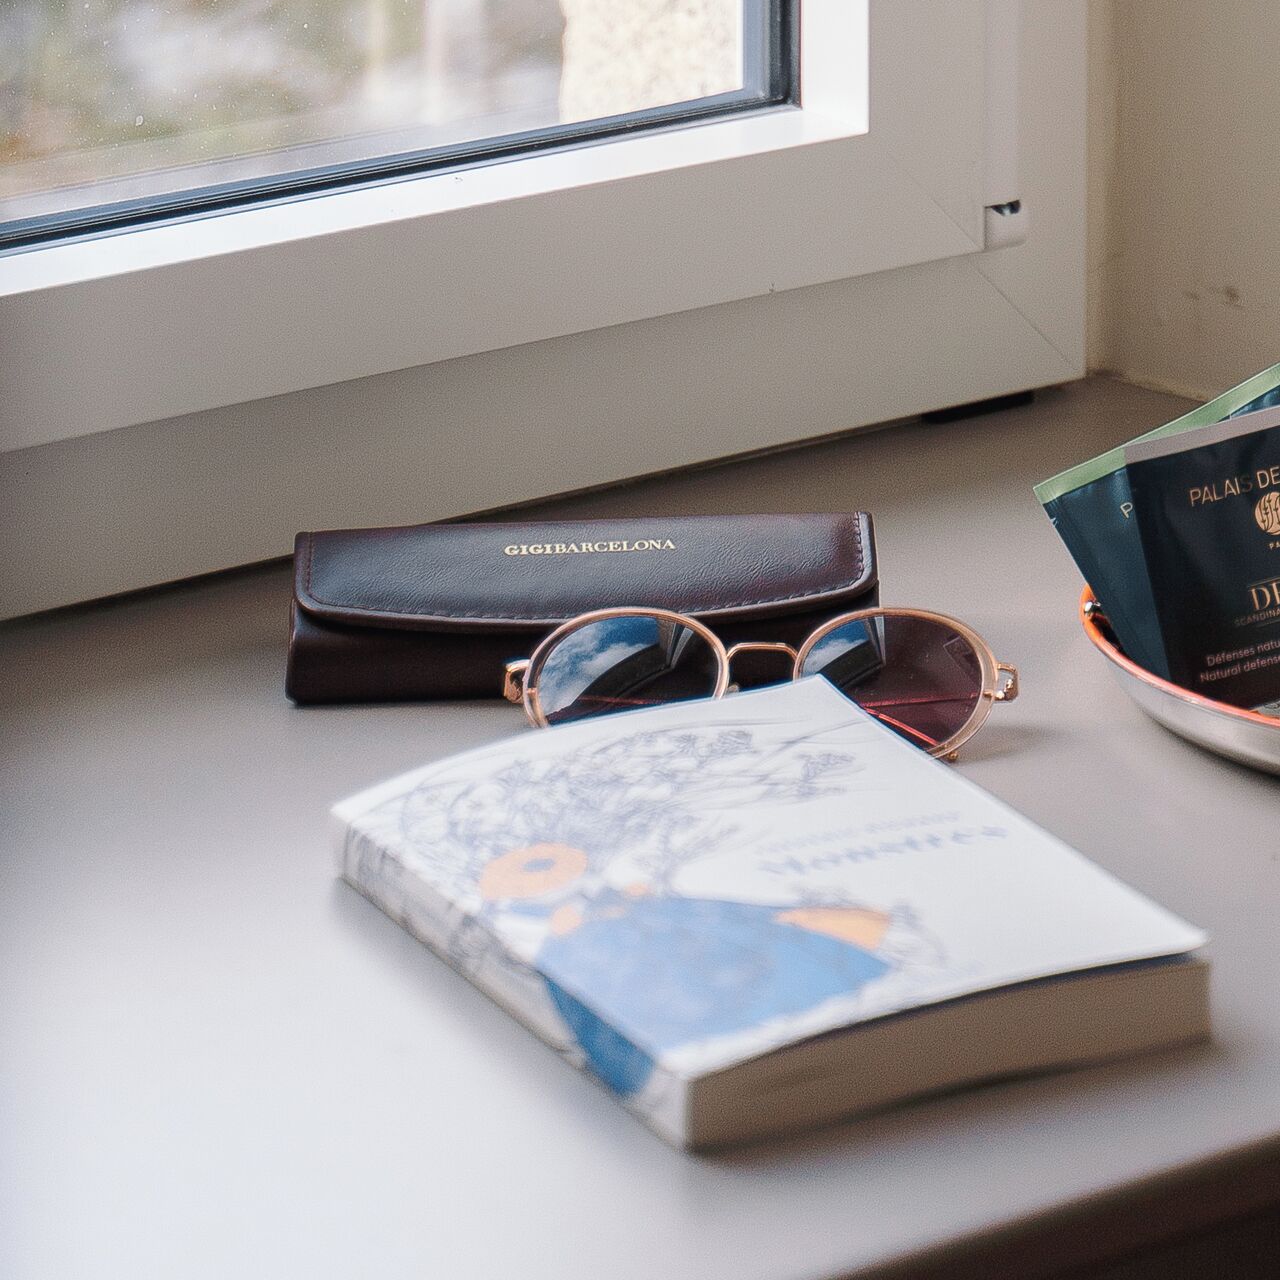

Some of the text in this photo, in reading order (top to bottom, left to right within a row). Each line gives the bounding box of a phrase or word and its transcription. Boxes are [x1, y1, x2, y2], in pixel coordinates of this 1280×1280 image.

[1189, 476, 1253, 507] PALAIS
[504, 539, 676, 556] GIGIBARCELONA
[1206, 646, 1256, 668] Défenses
[1200, 664, 1242, 683] Natural
